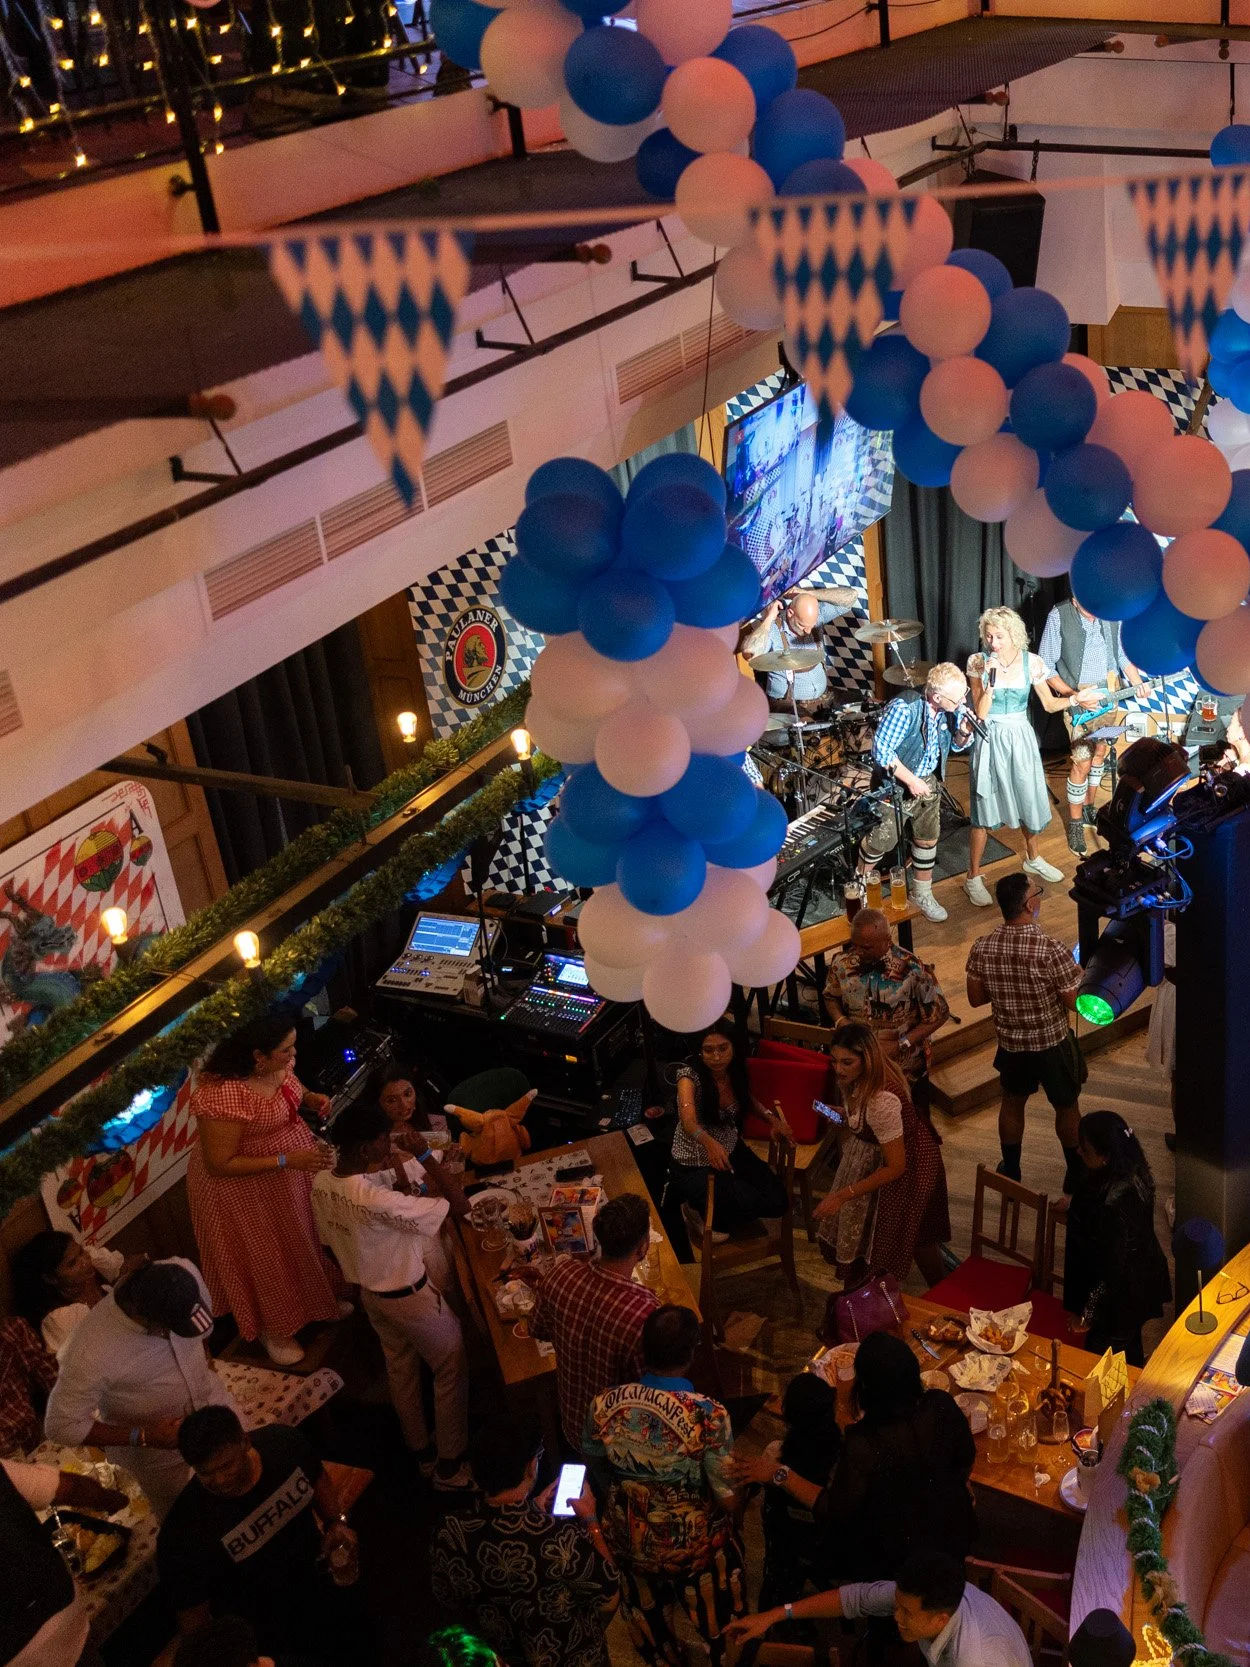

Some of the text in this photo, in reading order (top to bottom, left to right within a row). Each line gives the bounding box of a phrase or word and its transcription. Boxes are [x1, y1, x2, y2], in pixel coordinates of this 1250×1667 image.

[445, 610, 499, 662] PAULANER
[458, 665, 503, 704] MÜNCHEN
[129, 809, 144, 840] A
[227, 1476, 310, 1556] BUFFALO
